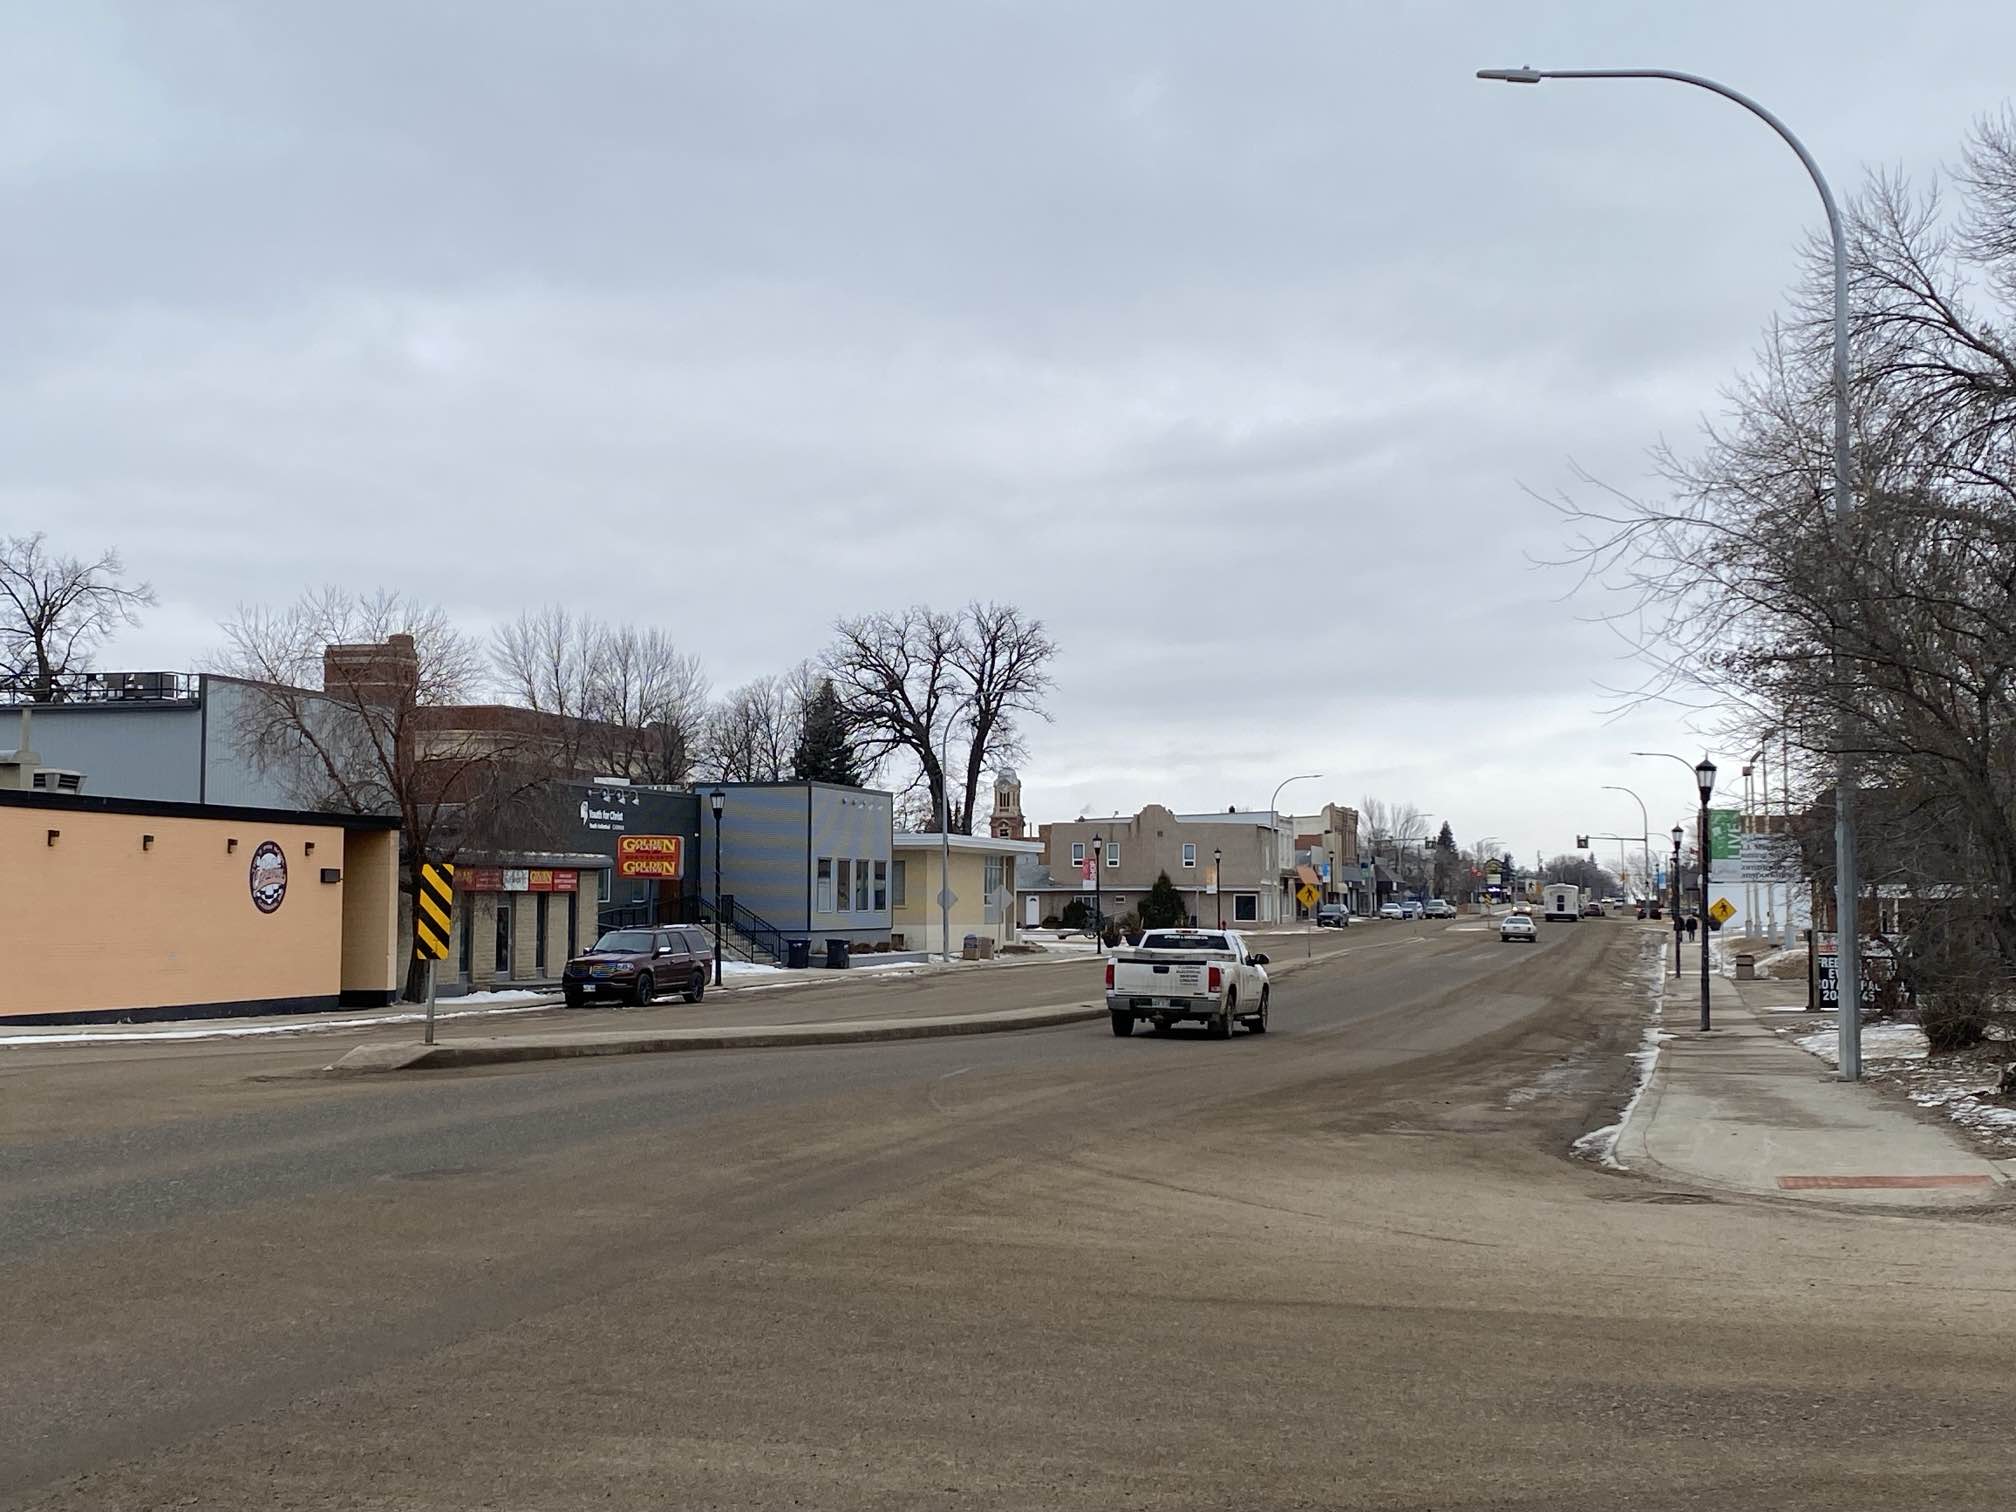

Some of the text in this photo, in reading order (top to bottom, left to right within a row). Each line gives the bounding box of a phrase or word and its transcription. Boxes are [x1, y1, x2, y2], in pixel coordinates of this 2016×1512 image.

[602, 810, 610, 819] for
[623, 839, 677, 853] GOLDEN
[1727, 823, 1742, 859] LIVE
[623, 861, 676, 876] GOLDEN
